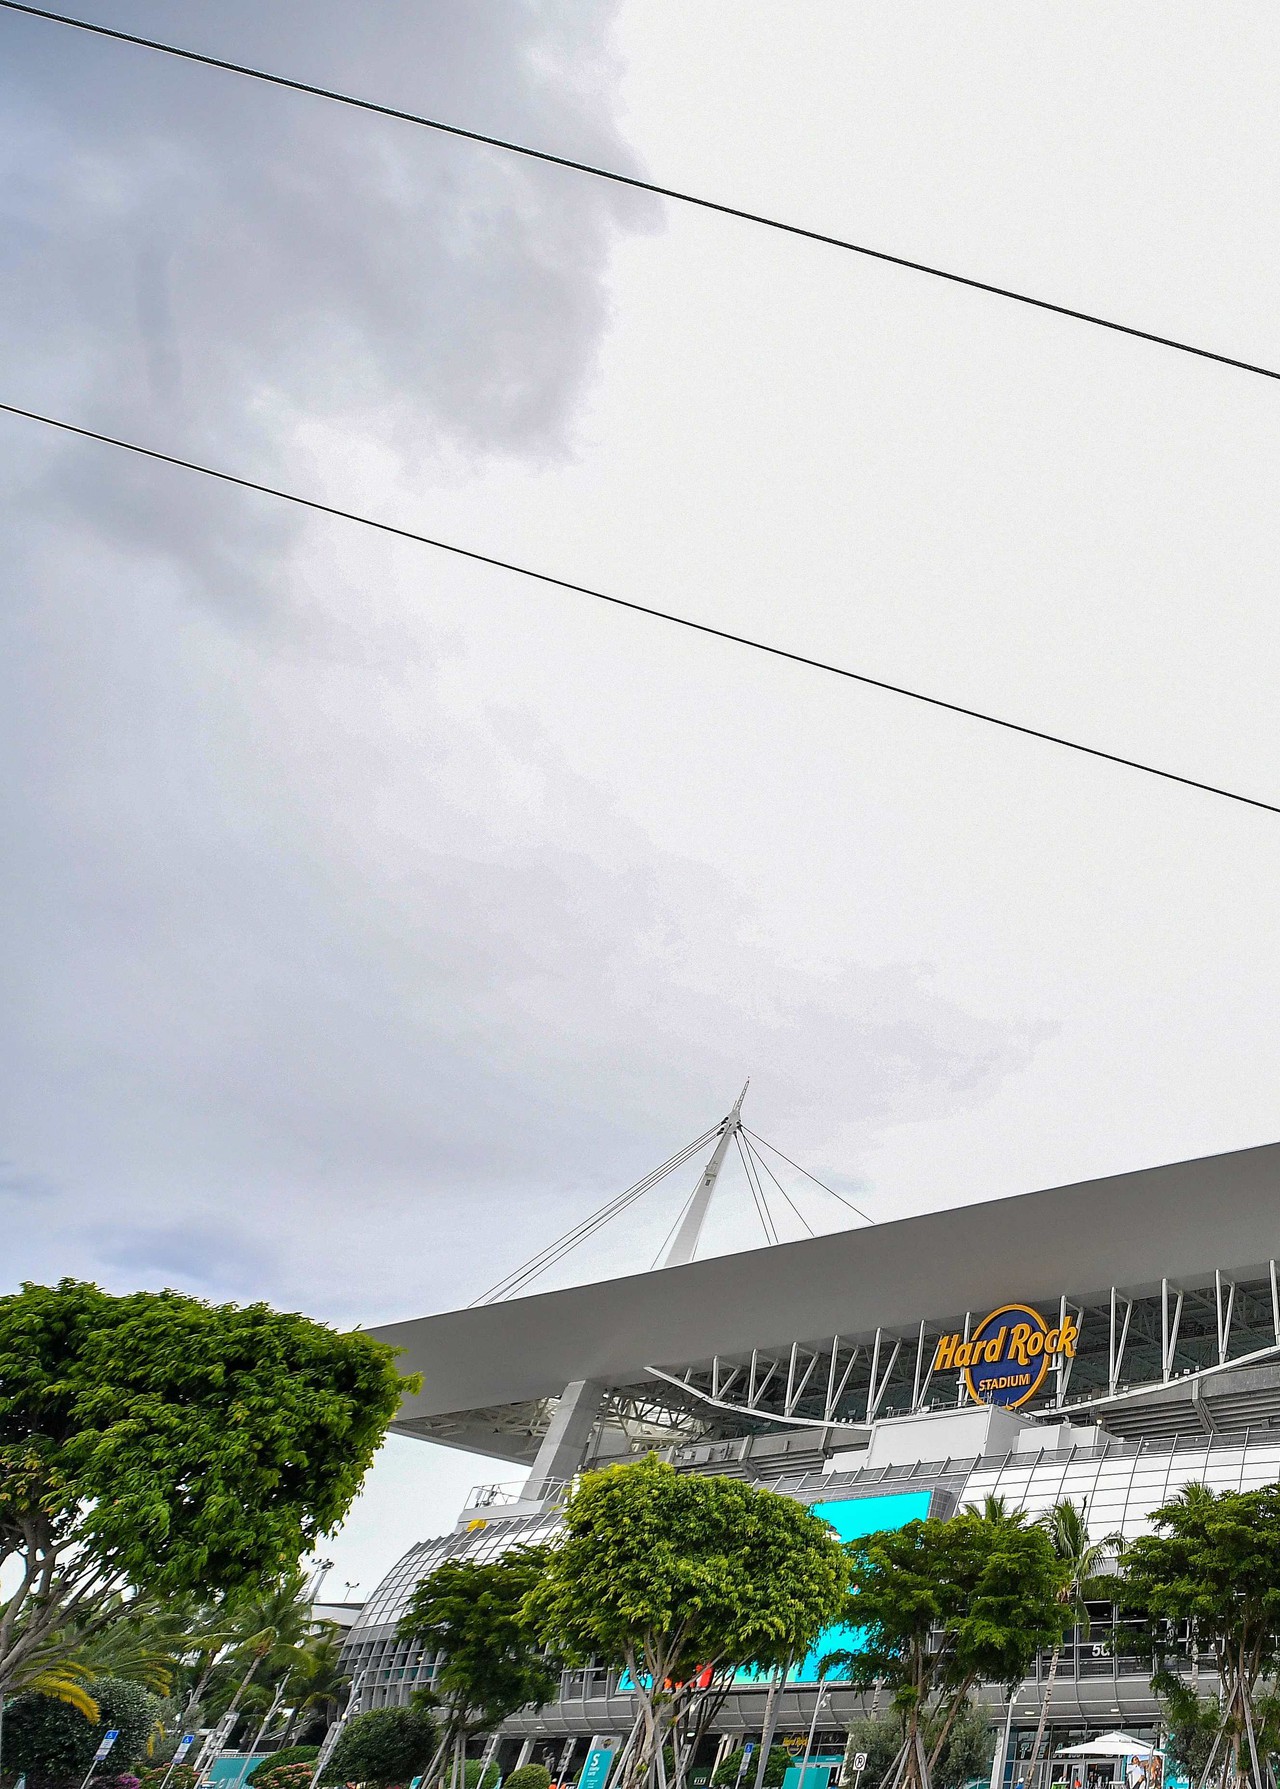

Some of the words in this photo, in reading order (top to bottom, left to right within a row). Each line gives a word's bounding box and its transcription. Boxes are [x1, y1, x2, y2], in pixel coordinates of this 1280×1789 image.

[934, 1325, 1007, 1370] Hard
[1008, 1316, 1077, 1366] Rock
[978, 1373, 1030, 1392] STADIUM
